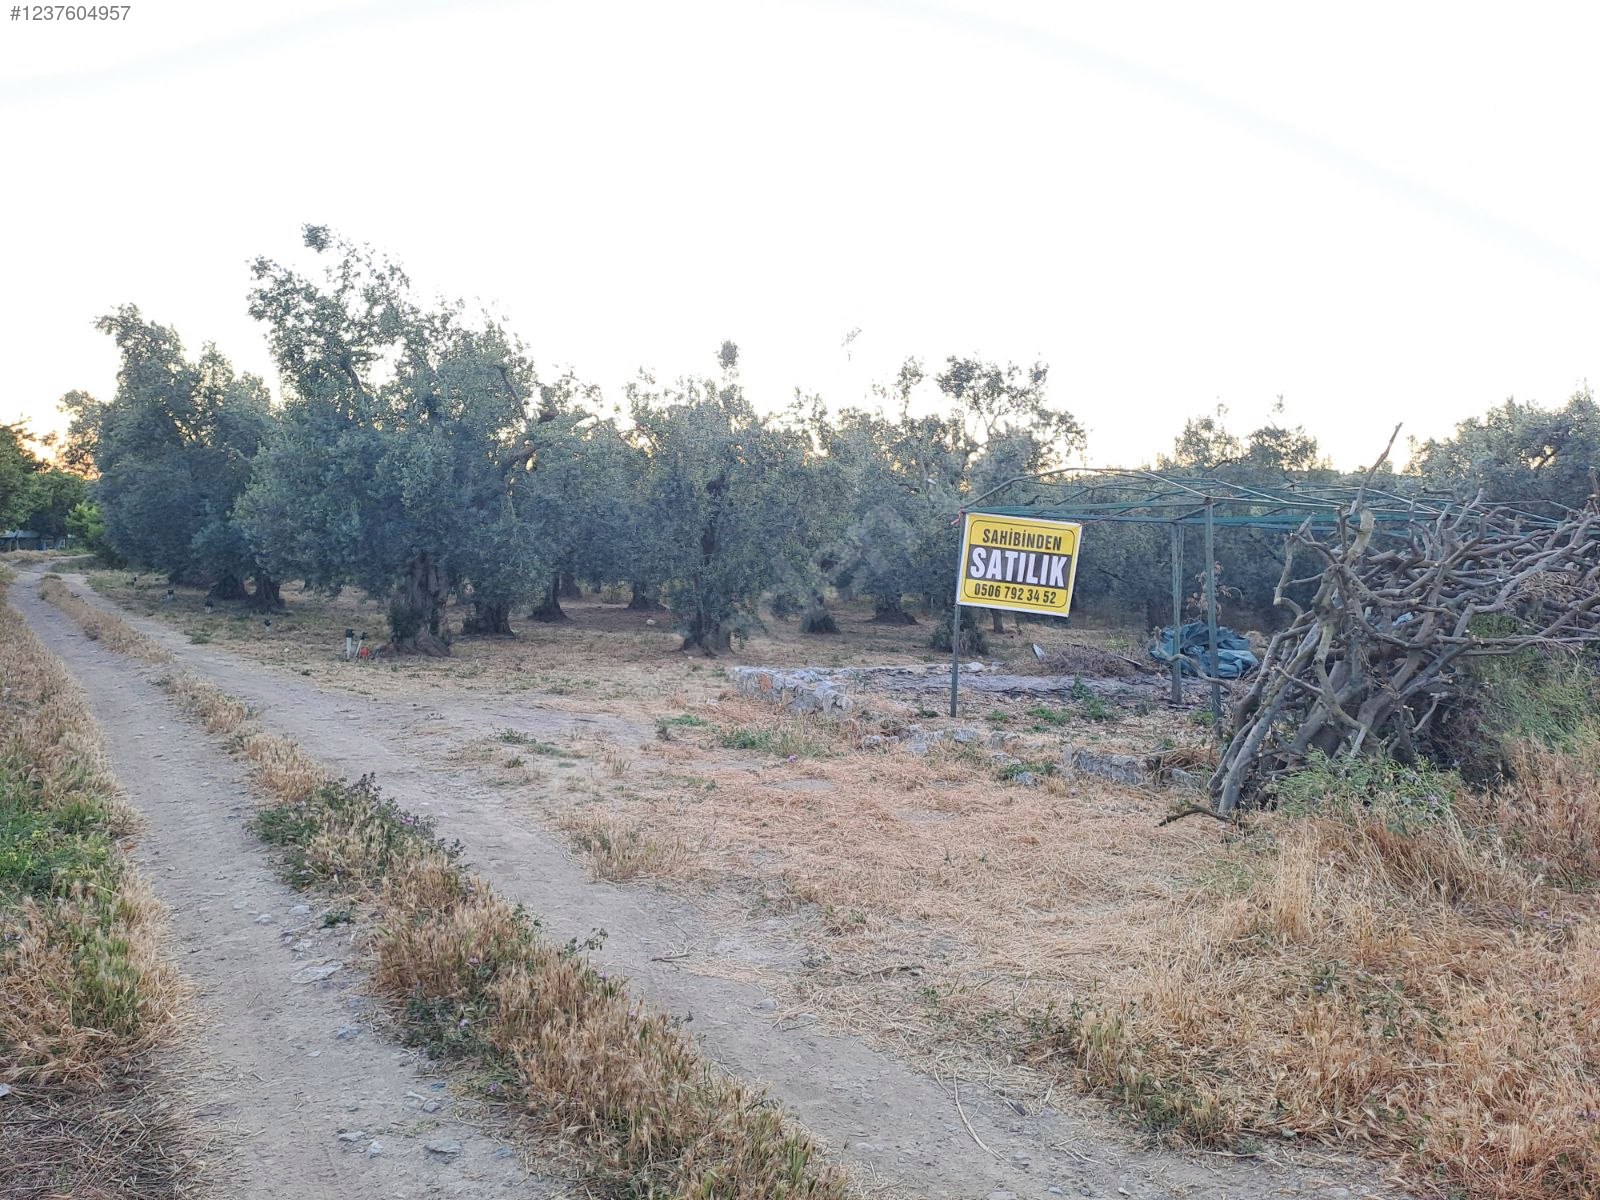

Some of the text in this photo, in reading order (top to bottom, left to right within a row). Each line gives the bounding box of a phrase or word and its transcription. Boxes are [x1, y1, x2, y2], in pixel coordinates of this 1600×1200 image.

[982, 528, 1062, 551] SAHİBİNDEN
[970, 547, 1068, 587] SATILIK
[974, 583, 1057, 604] 0506 792 34 52
